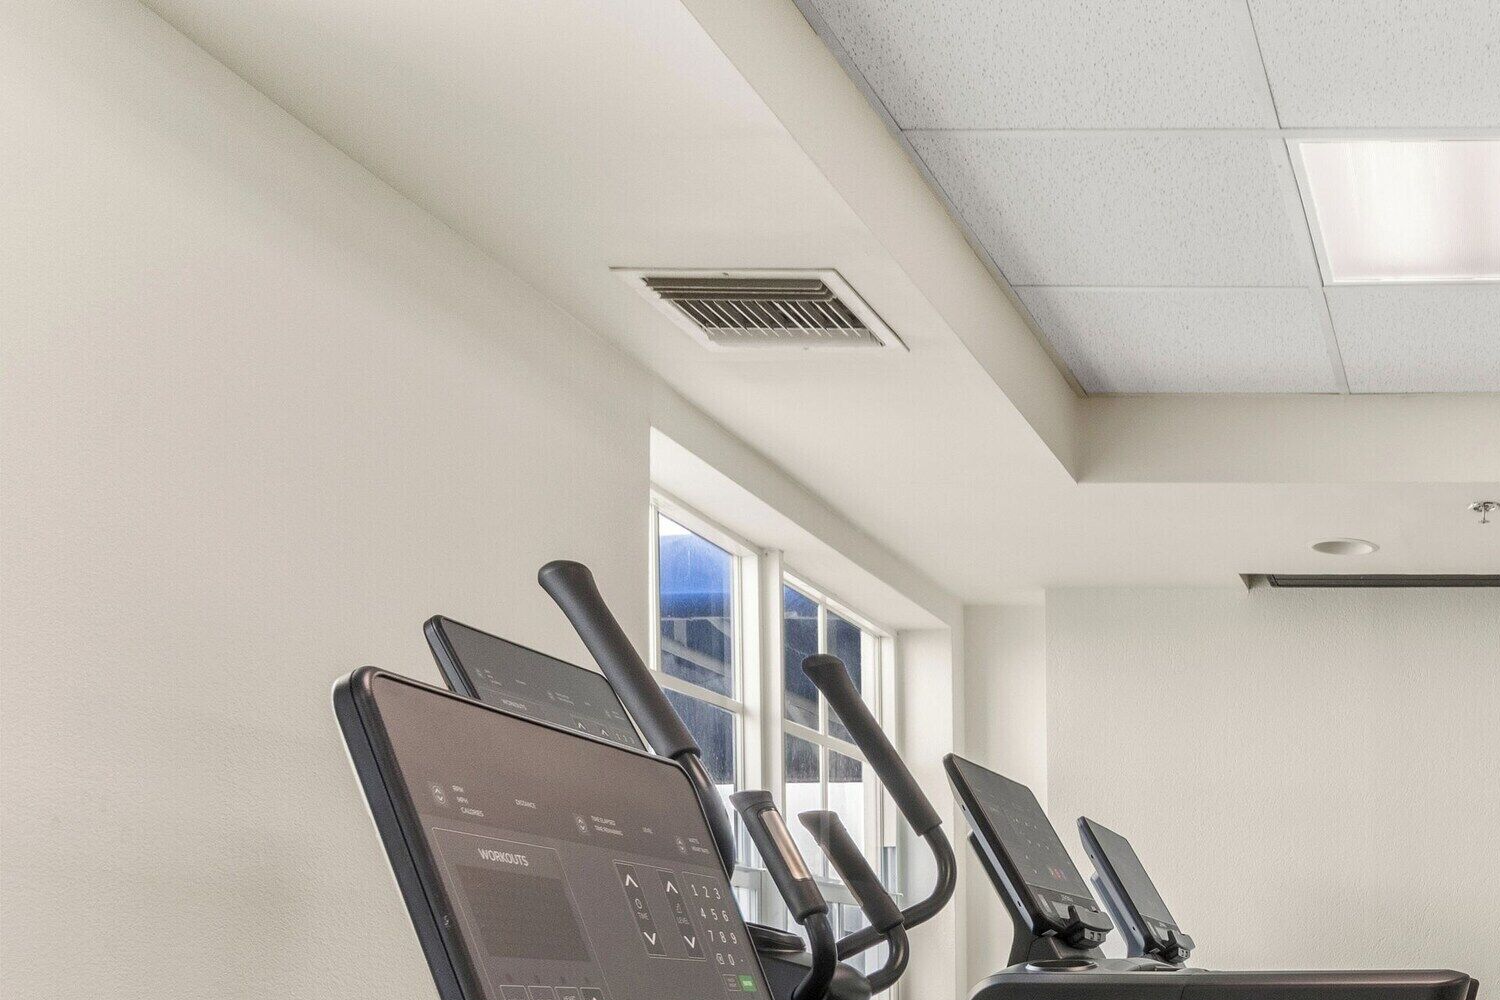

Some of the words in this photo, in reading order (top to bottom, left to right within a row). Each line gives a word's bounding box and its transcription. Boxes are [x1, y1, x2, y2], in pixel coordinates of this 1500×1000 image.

[478, 847, 529, 867] WORKOUTS
[691, 884, 698, 896] 1
[702, 886, 710, 898] 2
[713, 888, 721, 900] 3
[711, 908, 718, 921] 5
[721, 910, 729, 922] 6
[708, 930, 714, 942] 7
[719, 931, 727, 943] 8
[730, 932, 737, 944] 9
